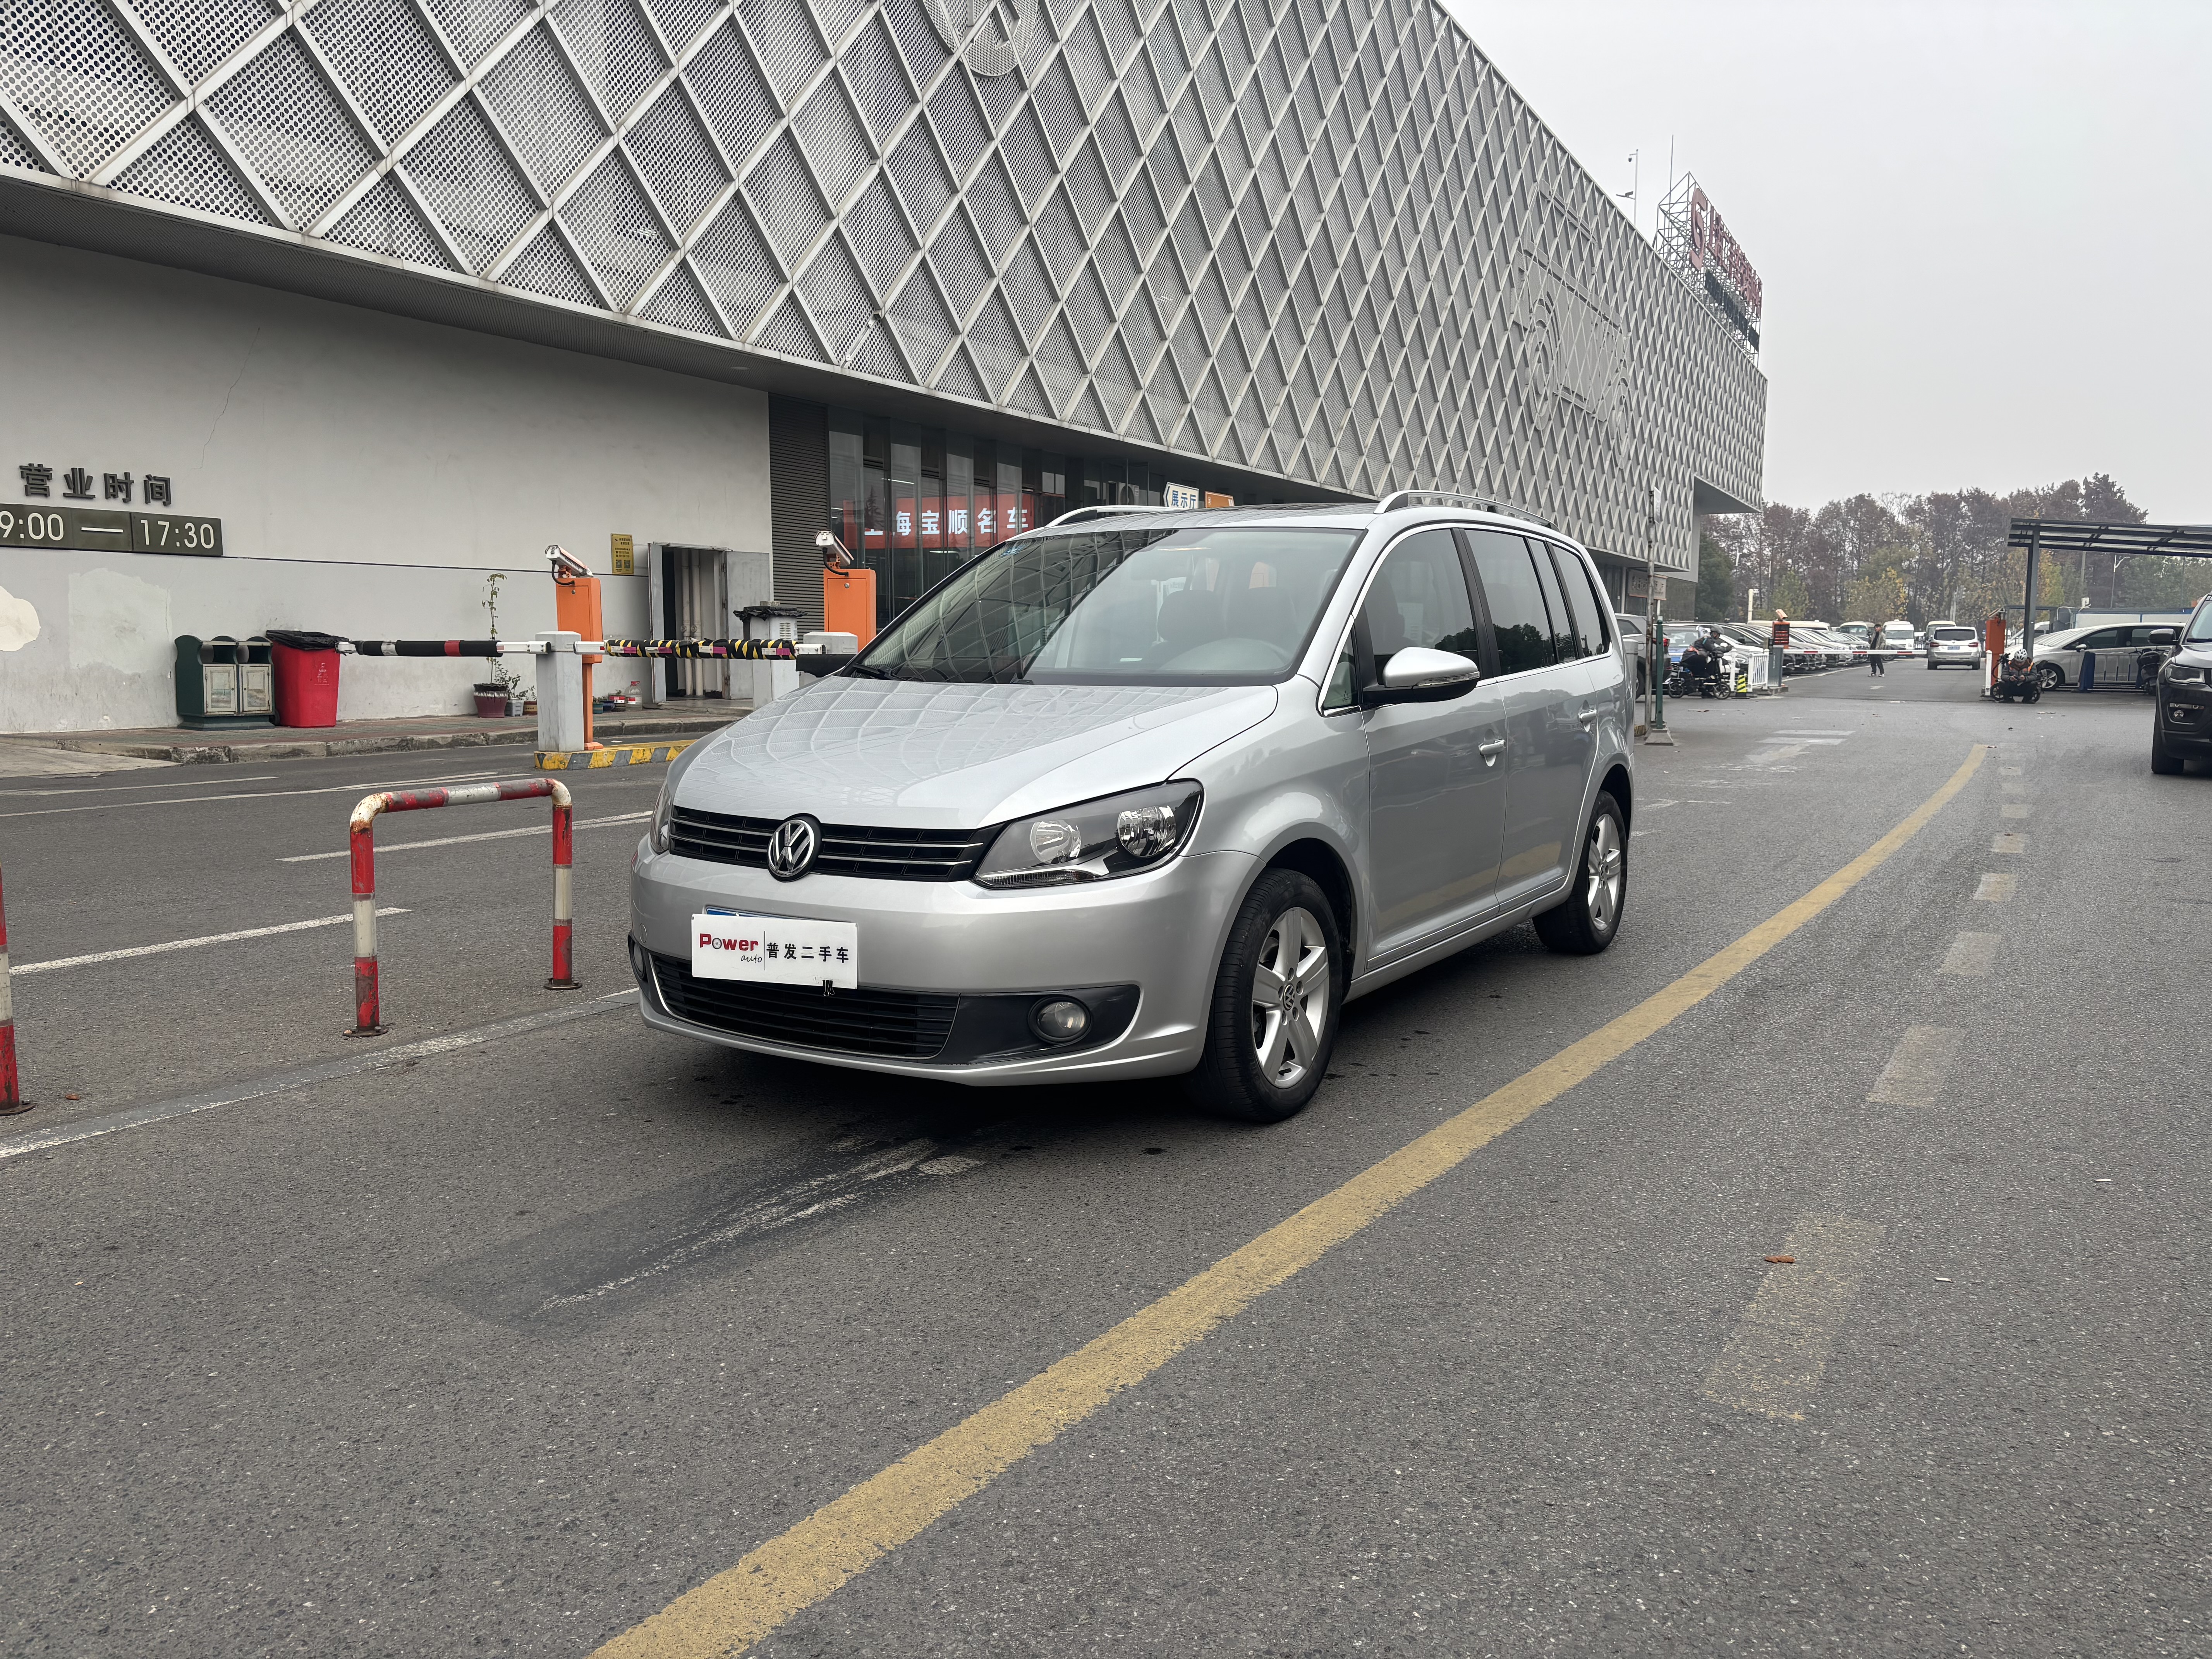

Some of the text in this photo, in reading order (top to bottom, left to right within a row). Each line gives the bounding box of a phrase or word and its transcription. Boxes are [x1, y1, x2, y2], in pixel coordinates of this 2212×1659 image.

[19, 463, 172, 506] 营业时间
[1171, 490, 1196, 508] 展示厅
[141, 519, 214, 549] 17:30
[700, 933, 759, 951] Power
[741, 954, 762, 964] auto
[766, 942, 849, 963] 普发二手车
